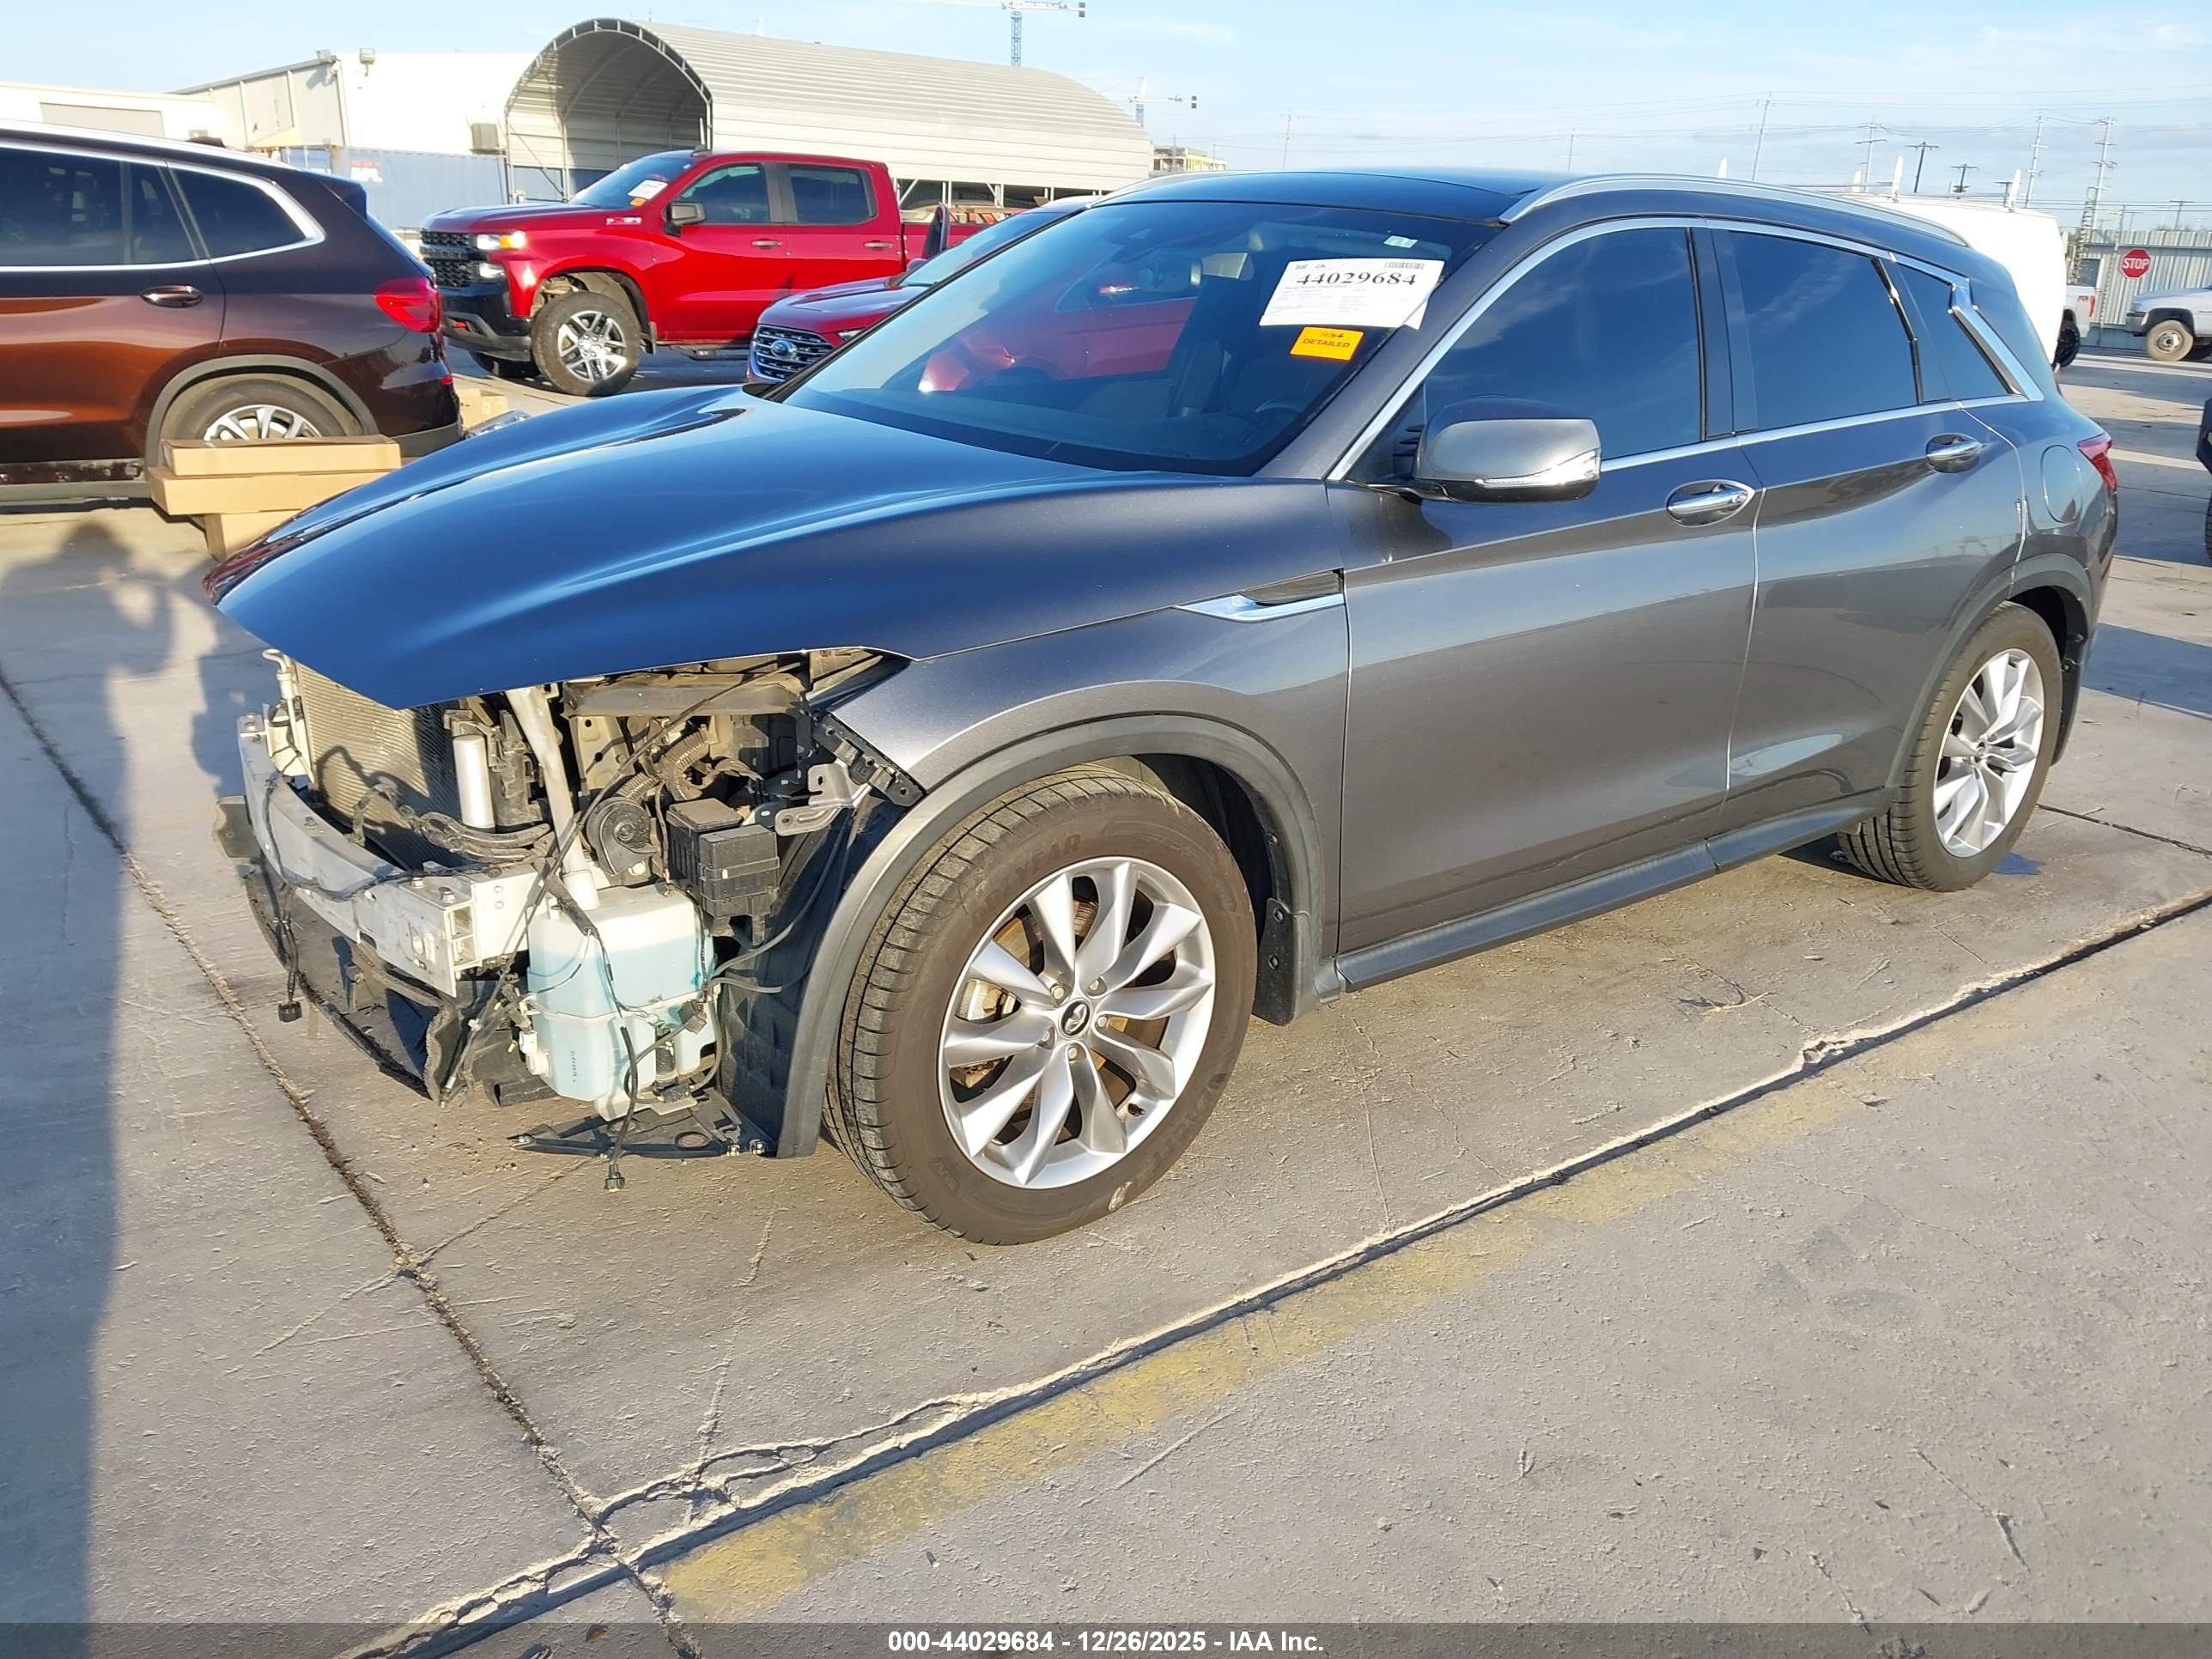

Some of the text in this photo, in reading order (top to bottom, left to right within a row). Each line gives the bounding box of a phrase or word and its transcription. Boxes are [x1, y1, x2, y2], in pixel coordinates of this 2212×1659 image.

[2123, 258, 2149, 269] STOP
[1297, 272, 1416, 285] 44029684
[1303, 338, 1351, 348] DETAILED
